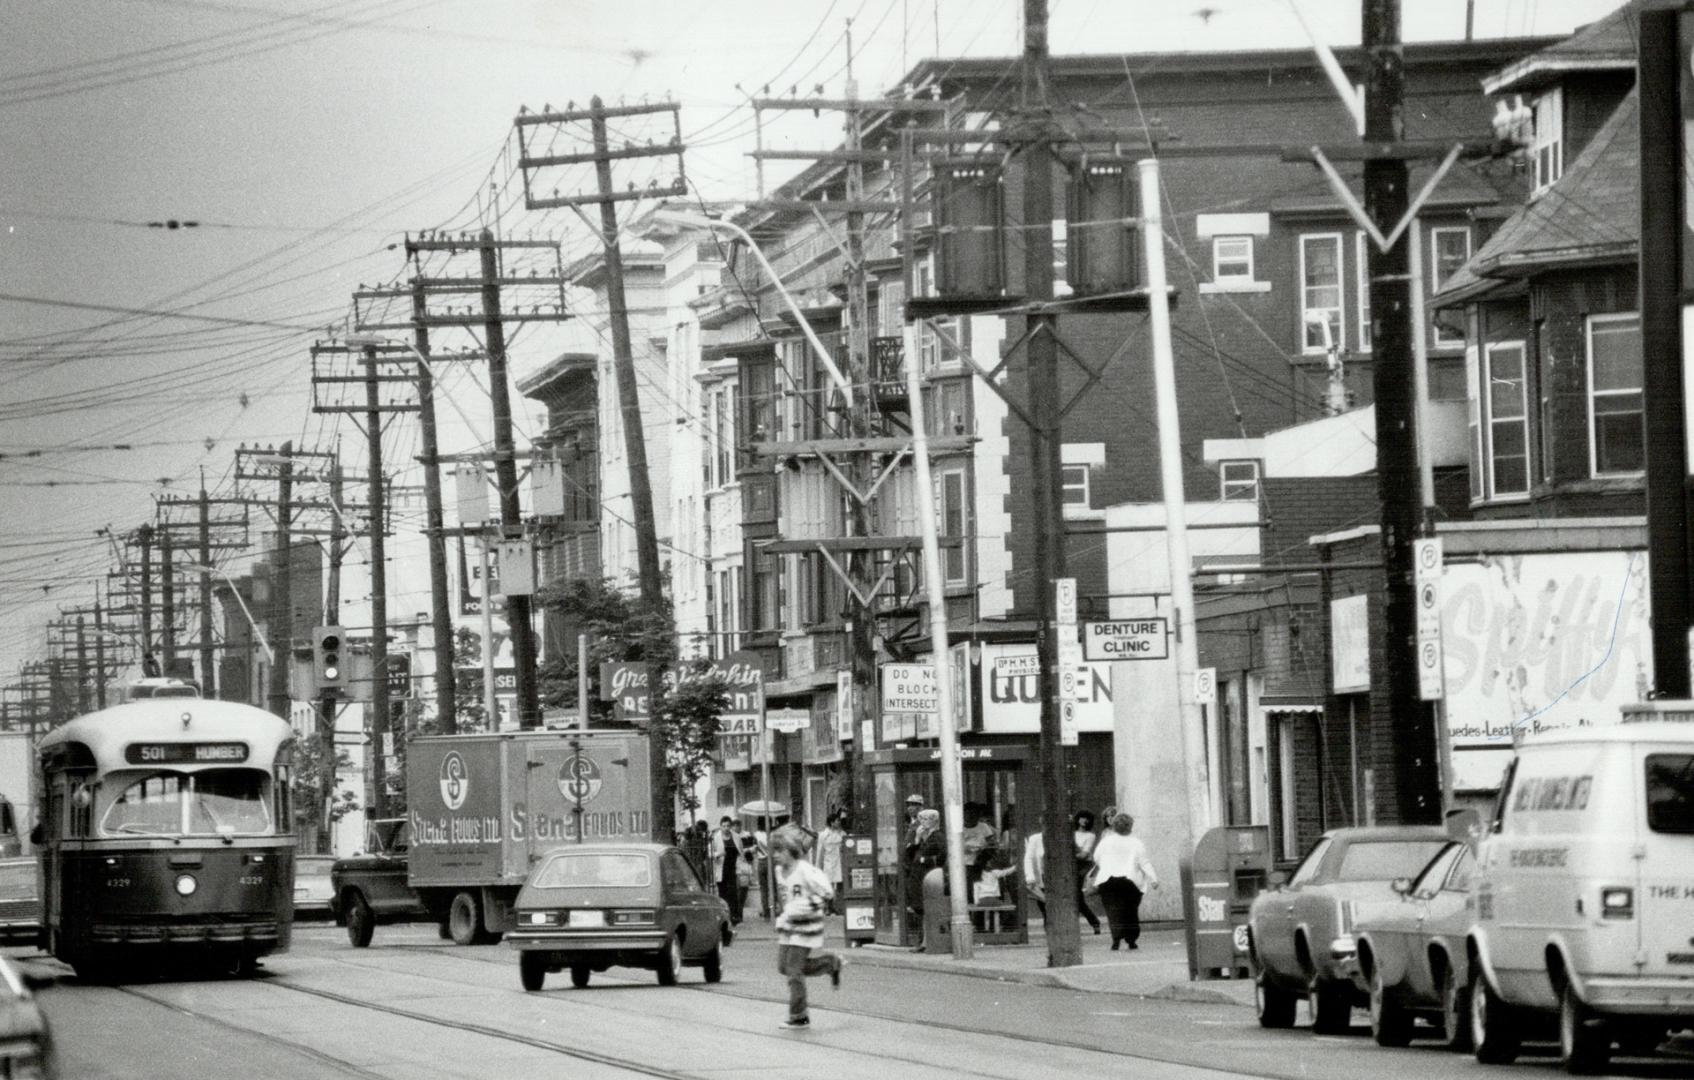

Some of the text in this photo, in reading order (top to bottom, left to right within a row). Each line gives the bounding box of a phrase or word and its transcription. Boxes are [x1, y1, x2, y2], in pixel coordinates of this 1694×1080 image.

[1094, 623, 1158, 636] DENTURE
[1103, 640, 1151, 653] CLINIC
[892, 669, 910, 680] DO
[990, 664, 1114, 704] QUEN
[885, 698, 938, 710] INTERSECT
[1450, 724, 1481, 737] uedes
[141, 746, 245, 760] 501 HUMBER
[1648, 885, 1678, 899] THE
[1198, 895, 1226, 922] Star
